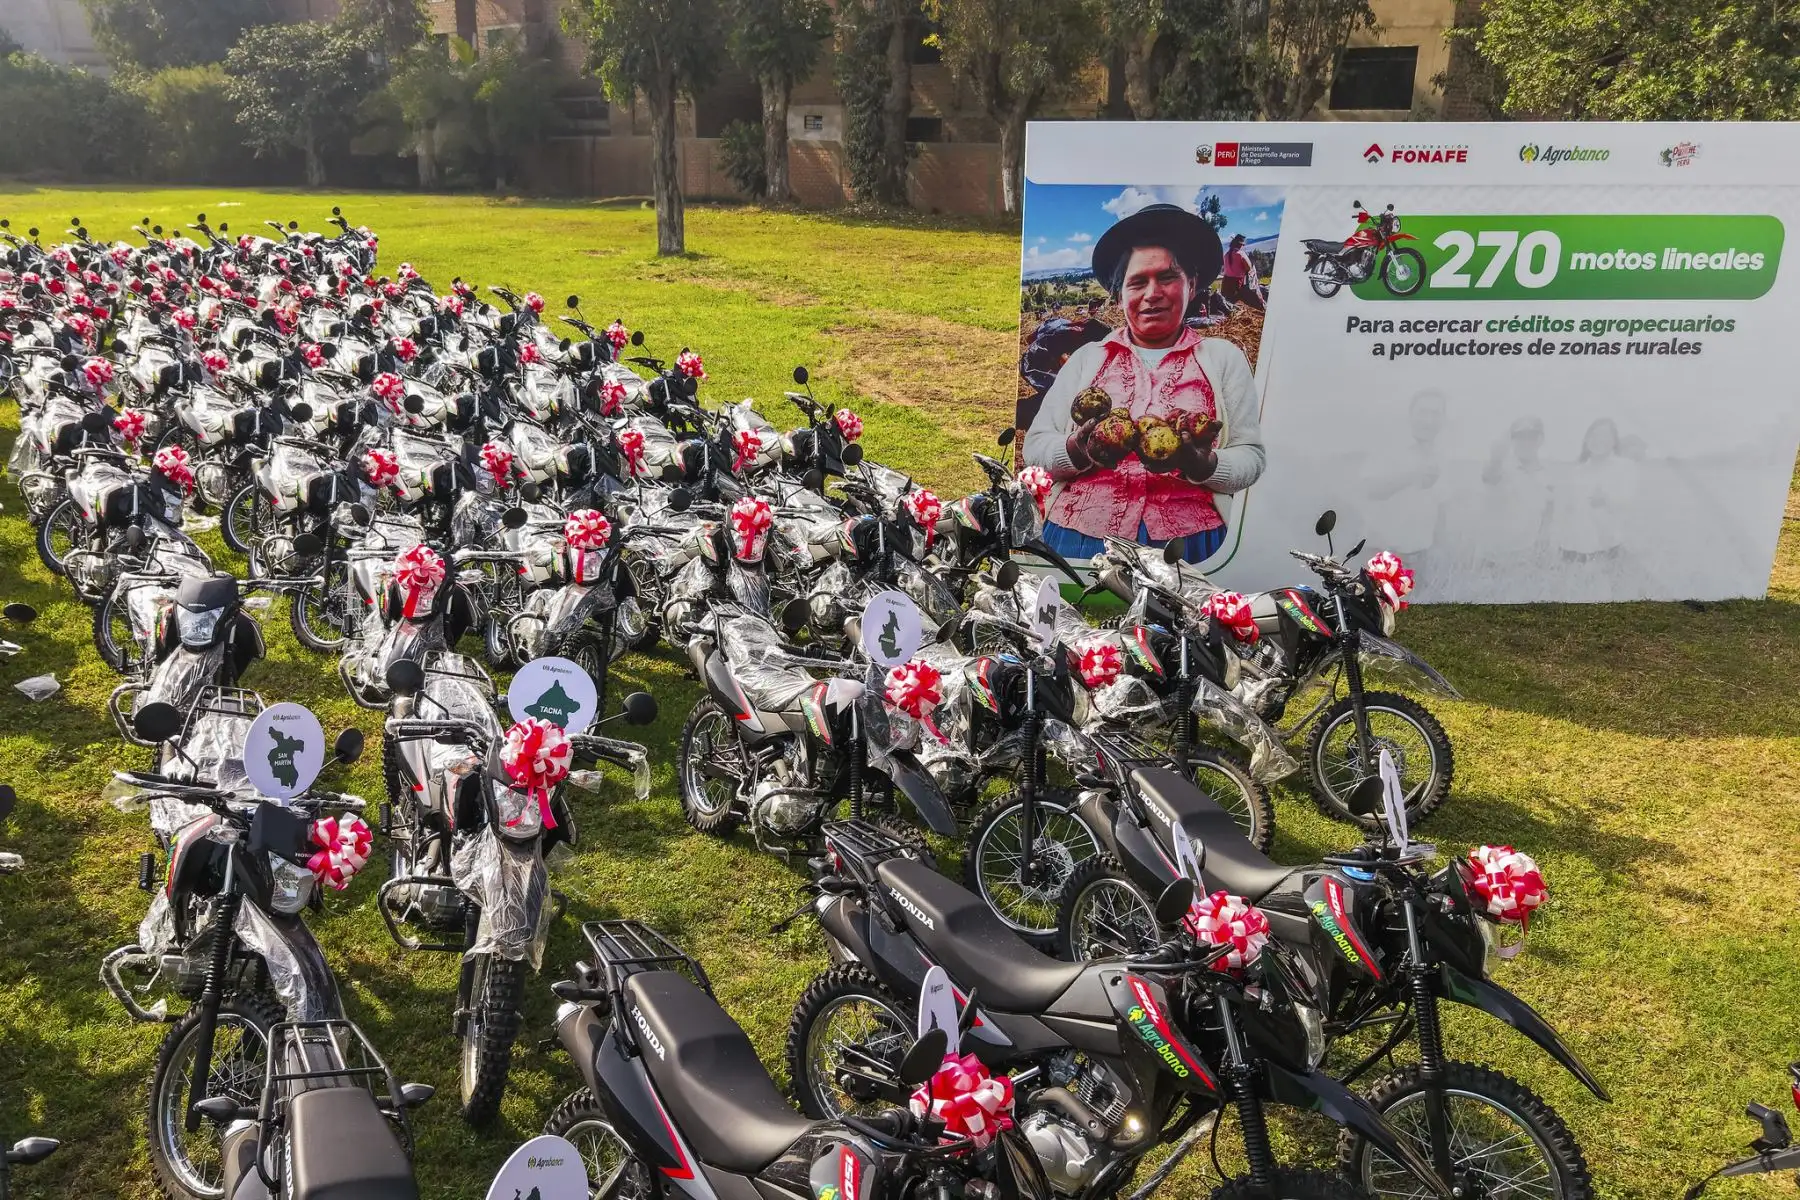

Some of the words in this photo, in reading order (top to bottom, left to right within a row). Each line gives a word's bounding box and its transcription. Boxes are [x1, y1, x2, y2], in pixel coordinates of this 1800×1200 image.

[1217, 150, 1236, 158] PERÚ
[1391, 150, 1468, 163] FONAFE
[1540, 146, 1610, 165] Agrobanco
[1429, 230, 1562, 289] 270
[1569, 248, 1656, 271] motos
[1661, 247, 1765, 271] lineales
[1346, 316, 1394, 333] Para
[1399, 318, 1483, 333] acercar
[1485, 315, 1575, 333] créditos
[1579, 315, 1736, 337] agropecuarios
[1372, 342, 1385, 356] a
[1389, 338, 1523, 360] productores
[1527, 338, 1556, 355] de
[1559, 341, 1622, 355] zonas
[1625, 337, 1703, 355] rurales
[540, 705, 563, 716] TACNA
[1138, 789, 1171, 828] HONDA
[889, 887, 935, 931] HONDA
[1320, 915, 1360, 963] Agrobanco
[631, 1004, 666, 1061] HONDA
[1138, 1023, 1189, 1078] Agrobanco
[844, 1153, 855, 1200] 150
